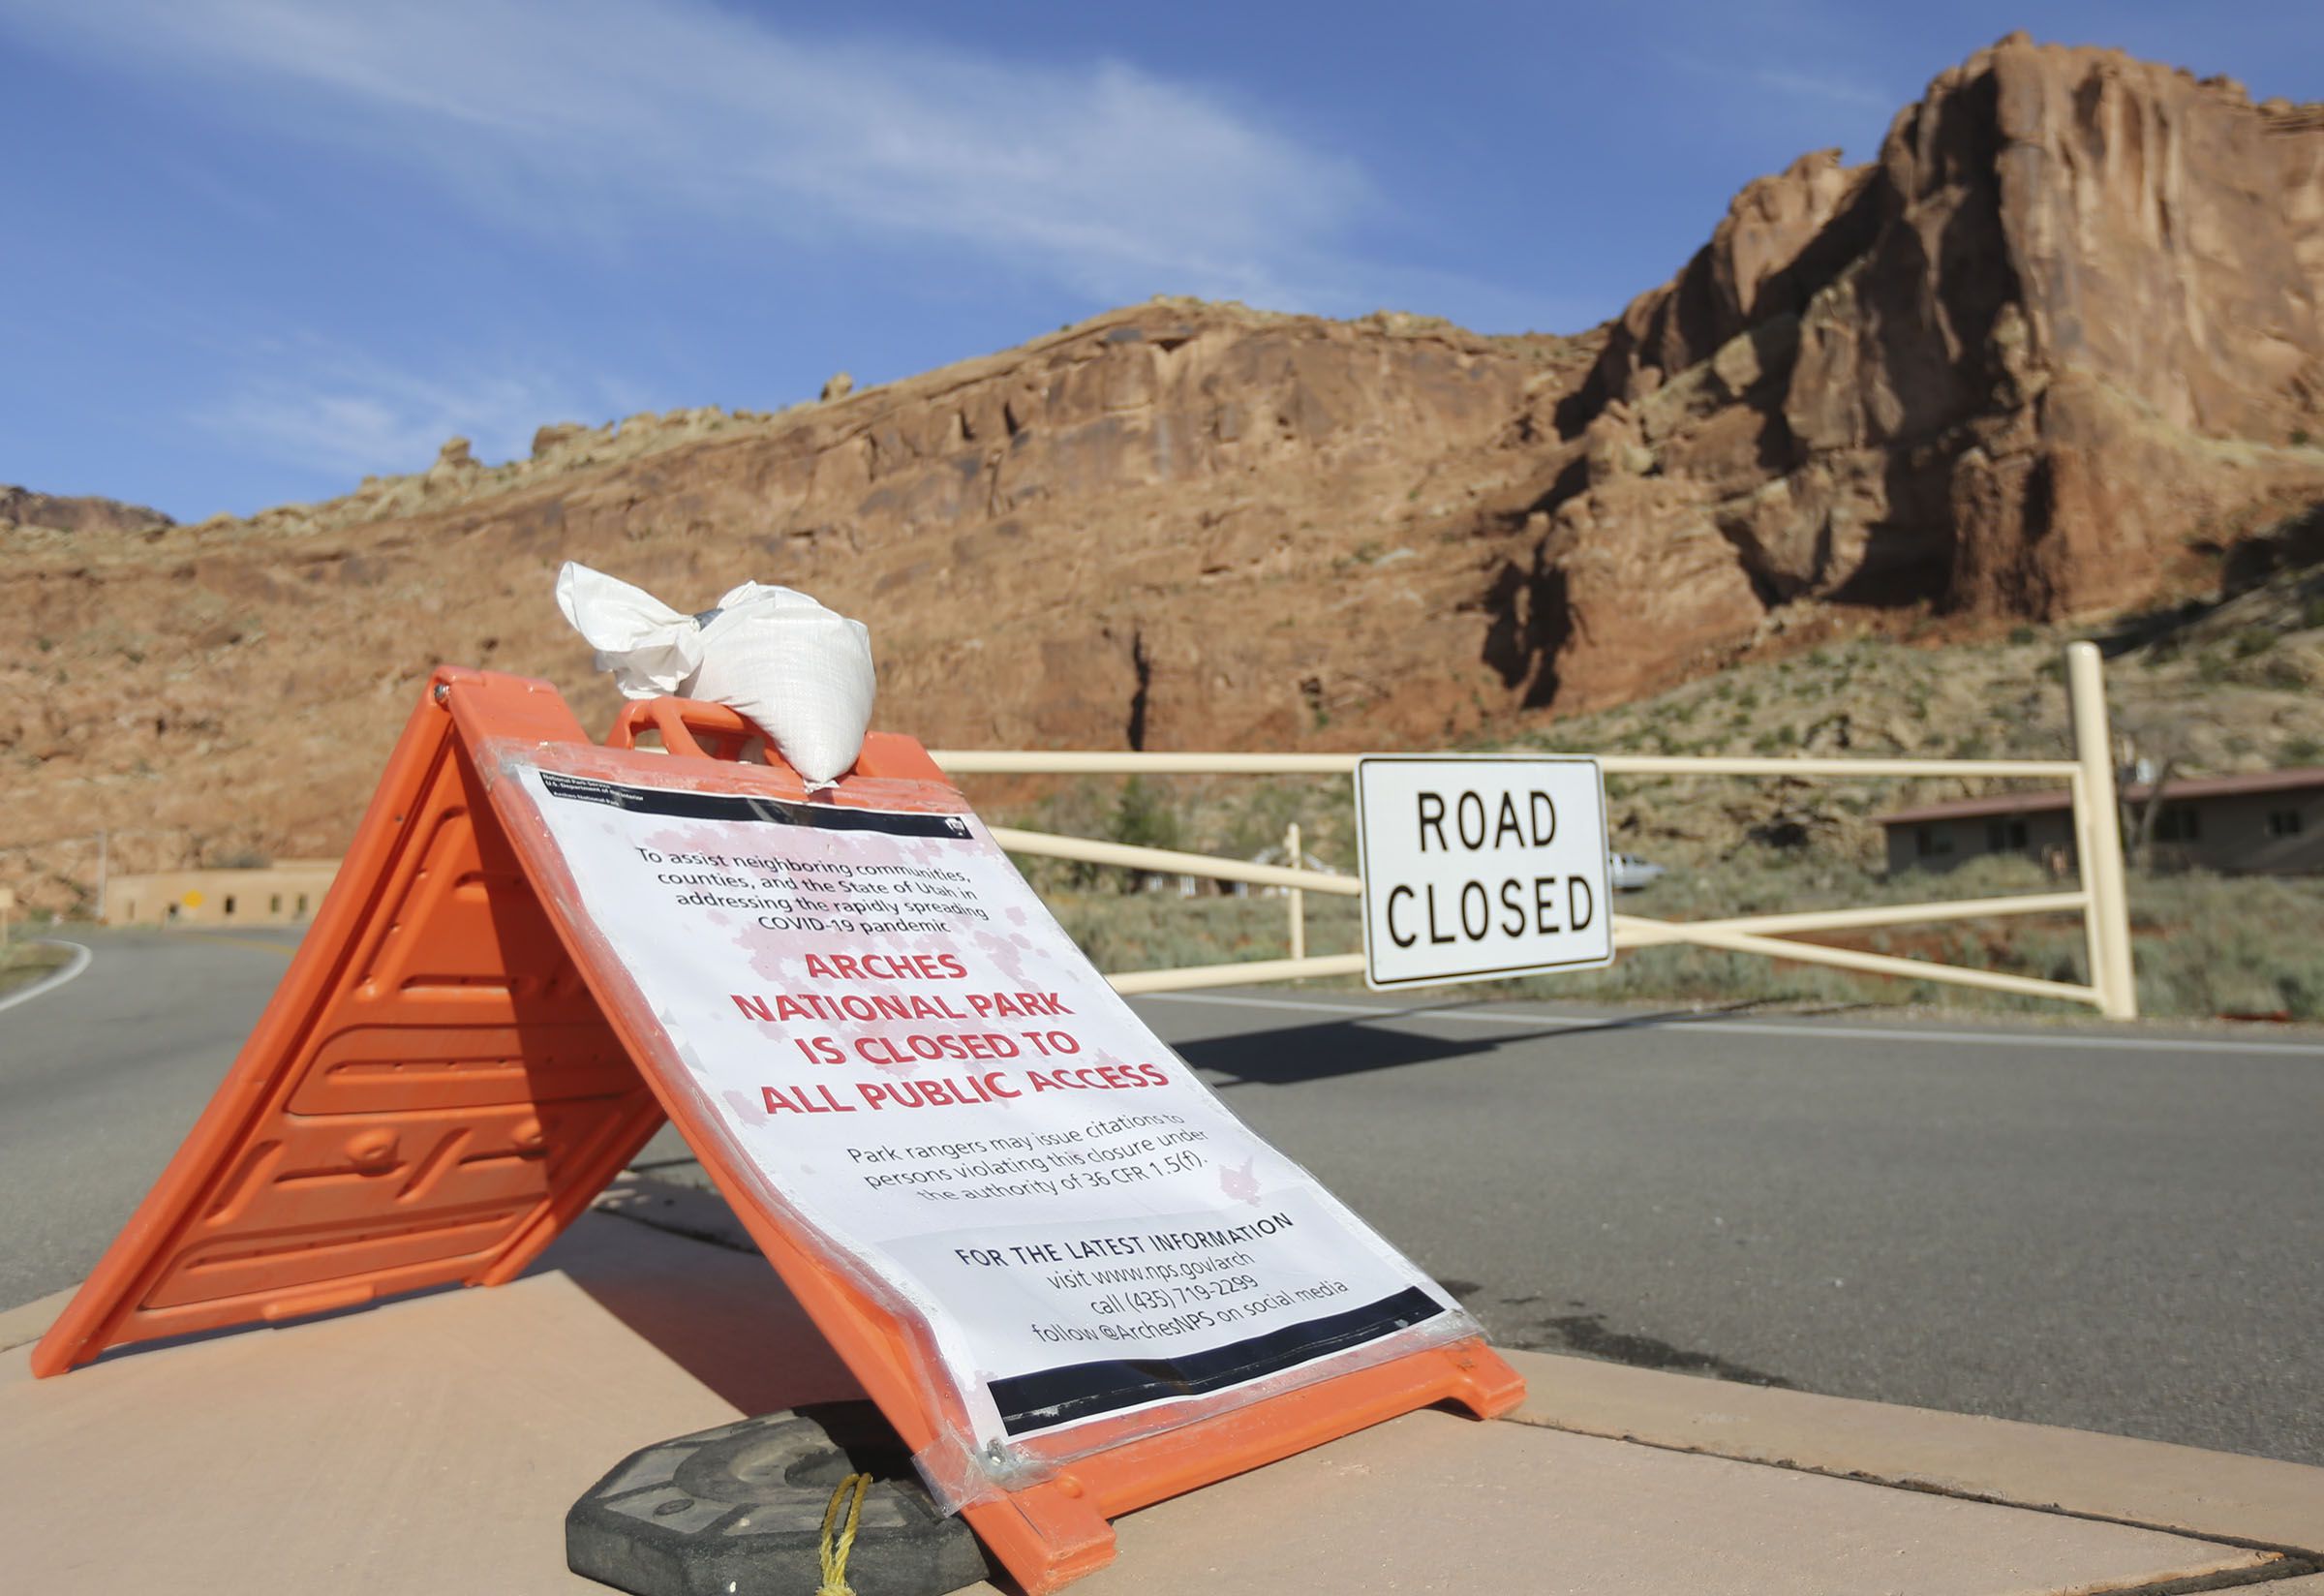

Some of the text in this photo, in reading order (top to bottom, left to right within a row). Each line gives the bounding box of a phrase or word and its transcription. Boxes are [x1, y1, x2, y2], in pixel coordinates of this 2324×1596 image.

[1418, 789, 1556, 852] ROAD
[635, 845, 971, 883] To assist neighboring communities,
[657, 873, 978, 901] counties, and the State of Utah in
[675, 891, 990, 921] addressing the rapidly spreading
[758, 916, 952, 936] COVID-19 pandemic
[1387, 875, 1593, 949] CLOSED
[804, 953, 968, 980] ARCHES
[730, 991, 1076, 1022] NATIONAL PARK
[793, 1029, 1081, 1065] IS CLOSED TO
[760, 1062, 1170, 1116] ALL PUBLIC ACCESS
[846, 1114, 1185, 1163] Park rangers may issue citations to
[864, 1128, 1208, 1190] persons violating this closure under
[916, 1150, 1208, 1201] the authority of 36 CFR 1.5(f).
[954, 1212, 1294, 1267] FOR THE LATEST INFORMATION
[1047, 1251, 1255, 1289] visit www.nps.gov/arch
[1031, 1279, 1348, 1343] follow @ArchesNPS on social media
[1090, 1274, 1259, 1315] call (435) 719-2299
